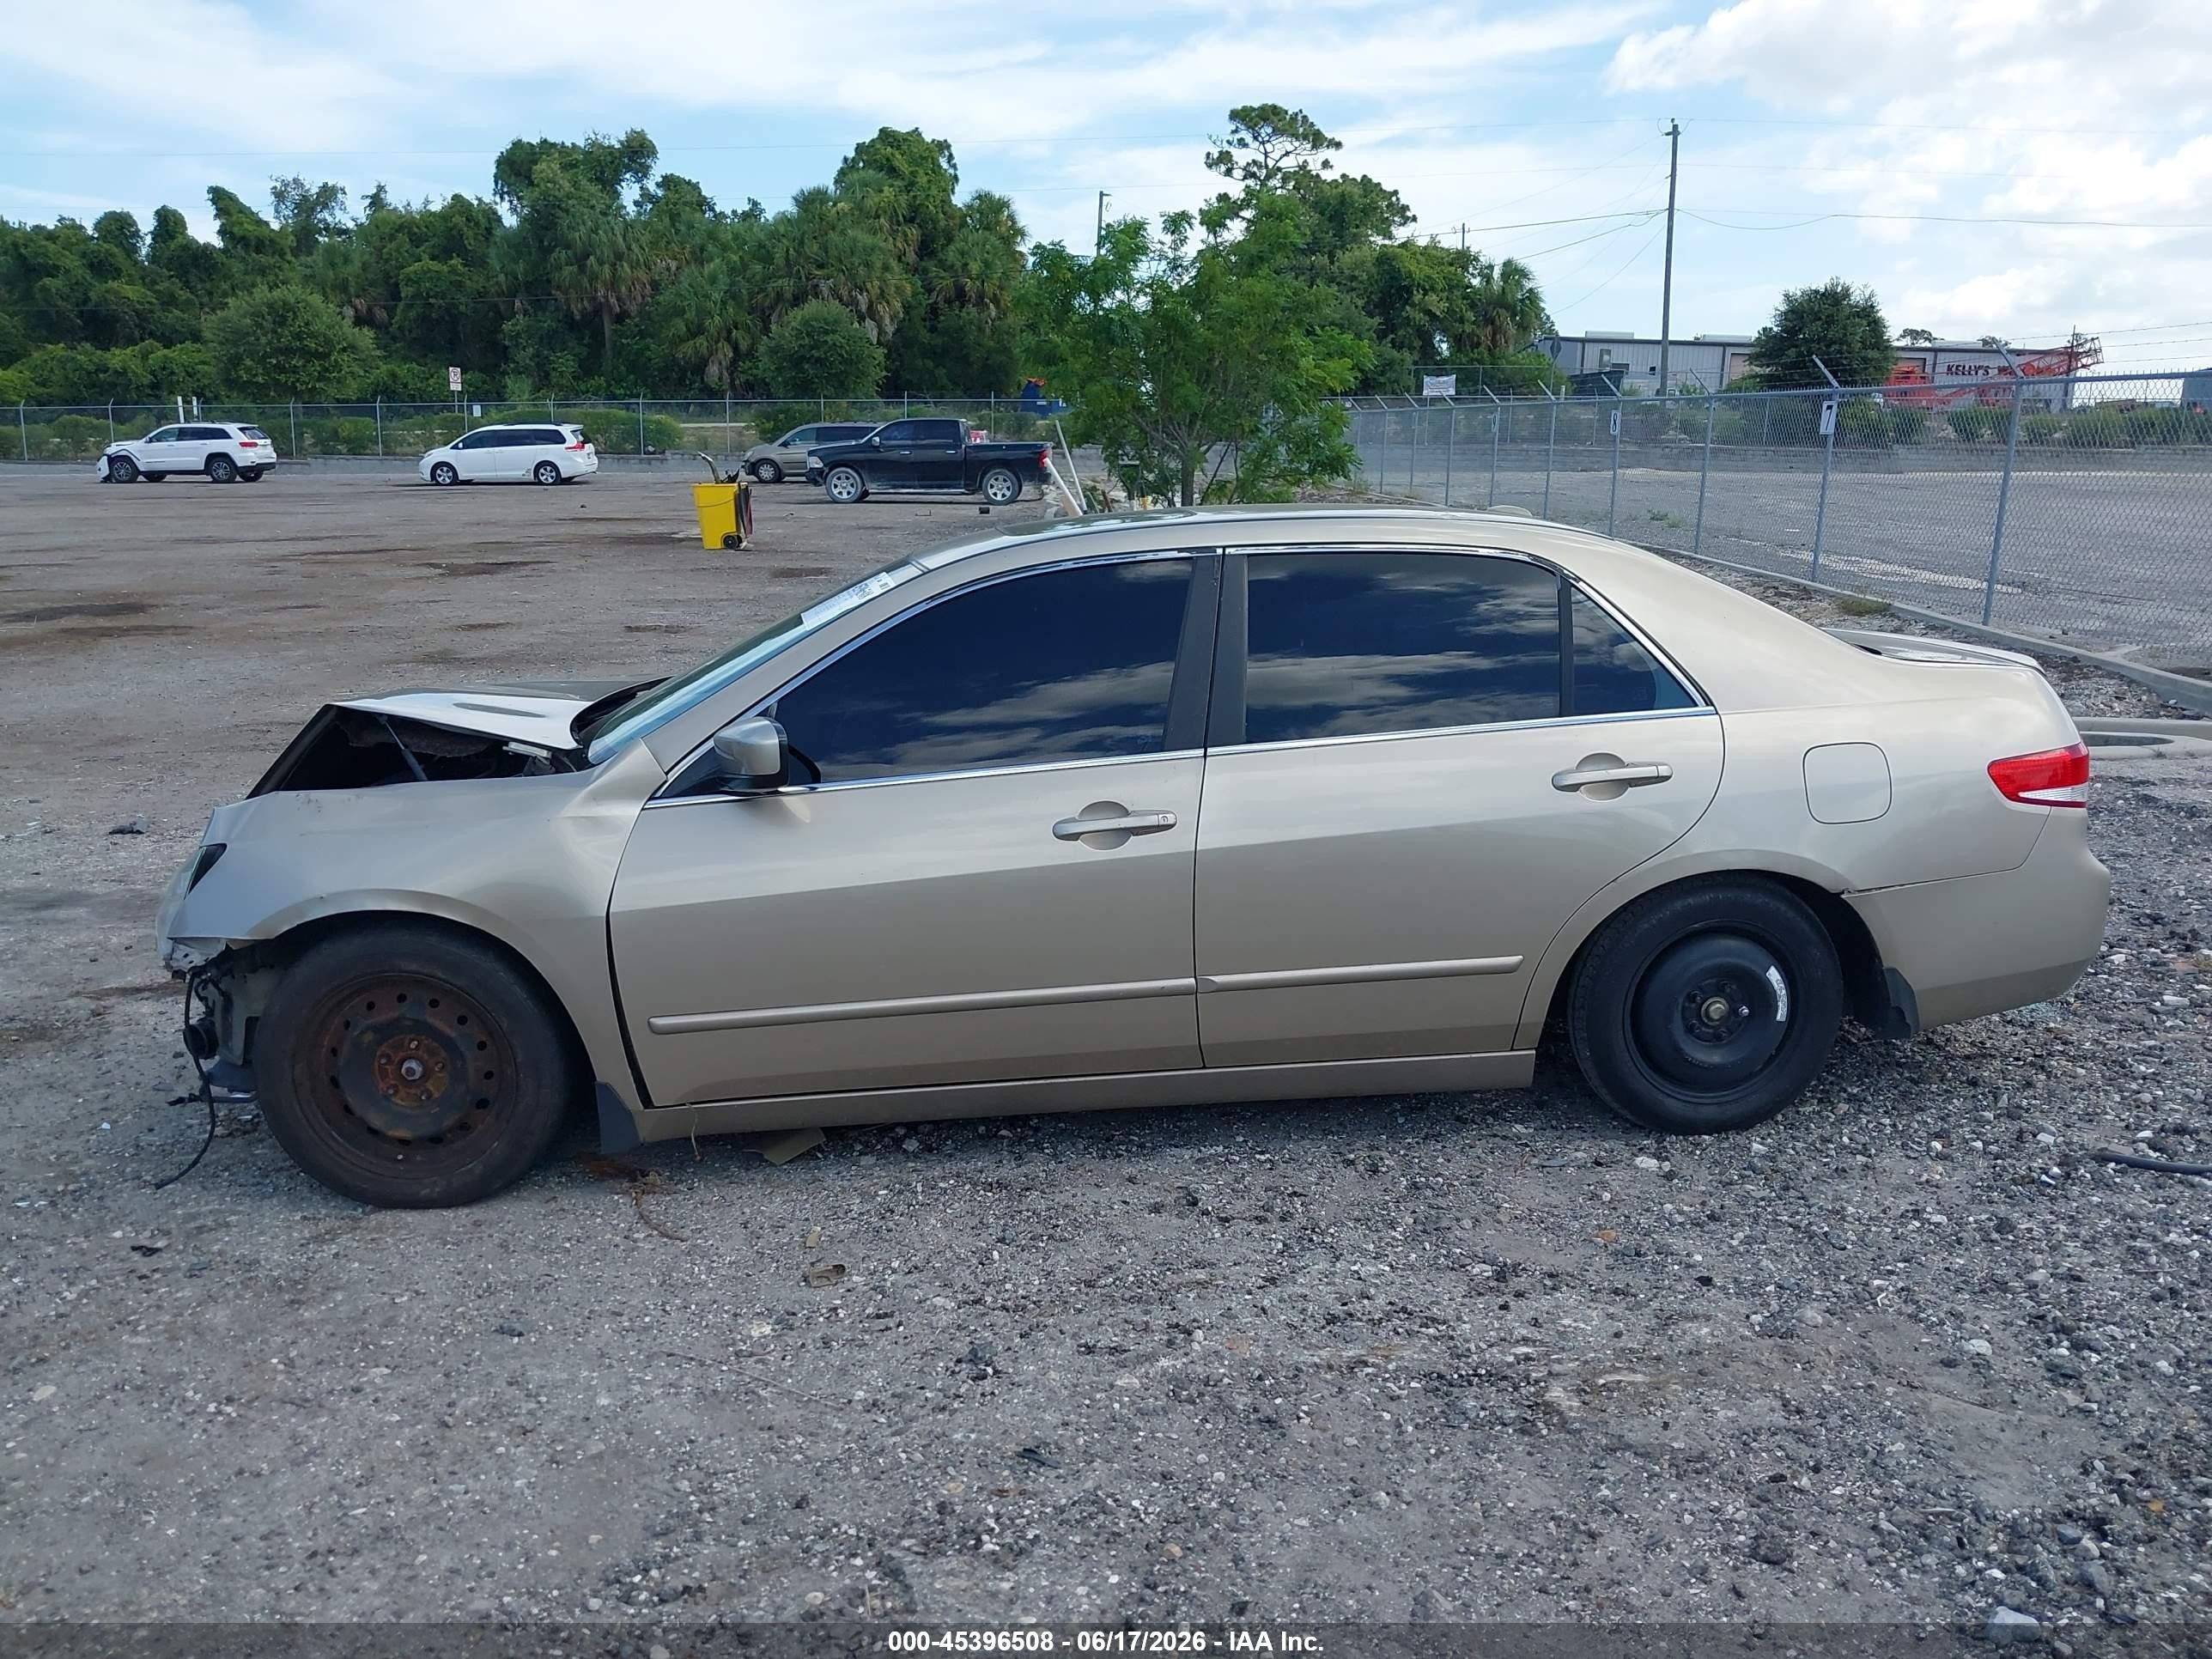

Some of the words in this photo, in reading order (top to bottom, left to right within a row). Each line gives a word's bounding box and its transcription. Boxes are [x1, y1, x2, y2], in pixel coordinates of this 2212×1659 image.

[1946, 363, 1990, 376] KELLY'S
[1612, 412, 1618, 433] 8
[1826, 404, 1834, 431] 7
